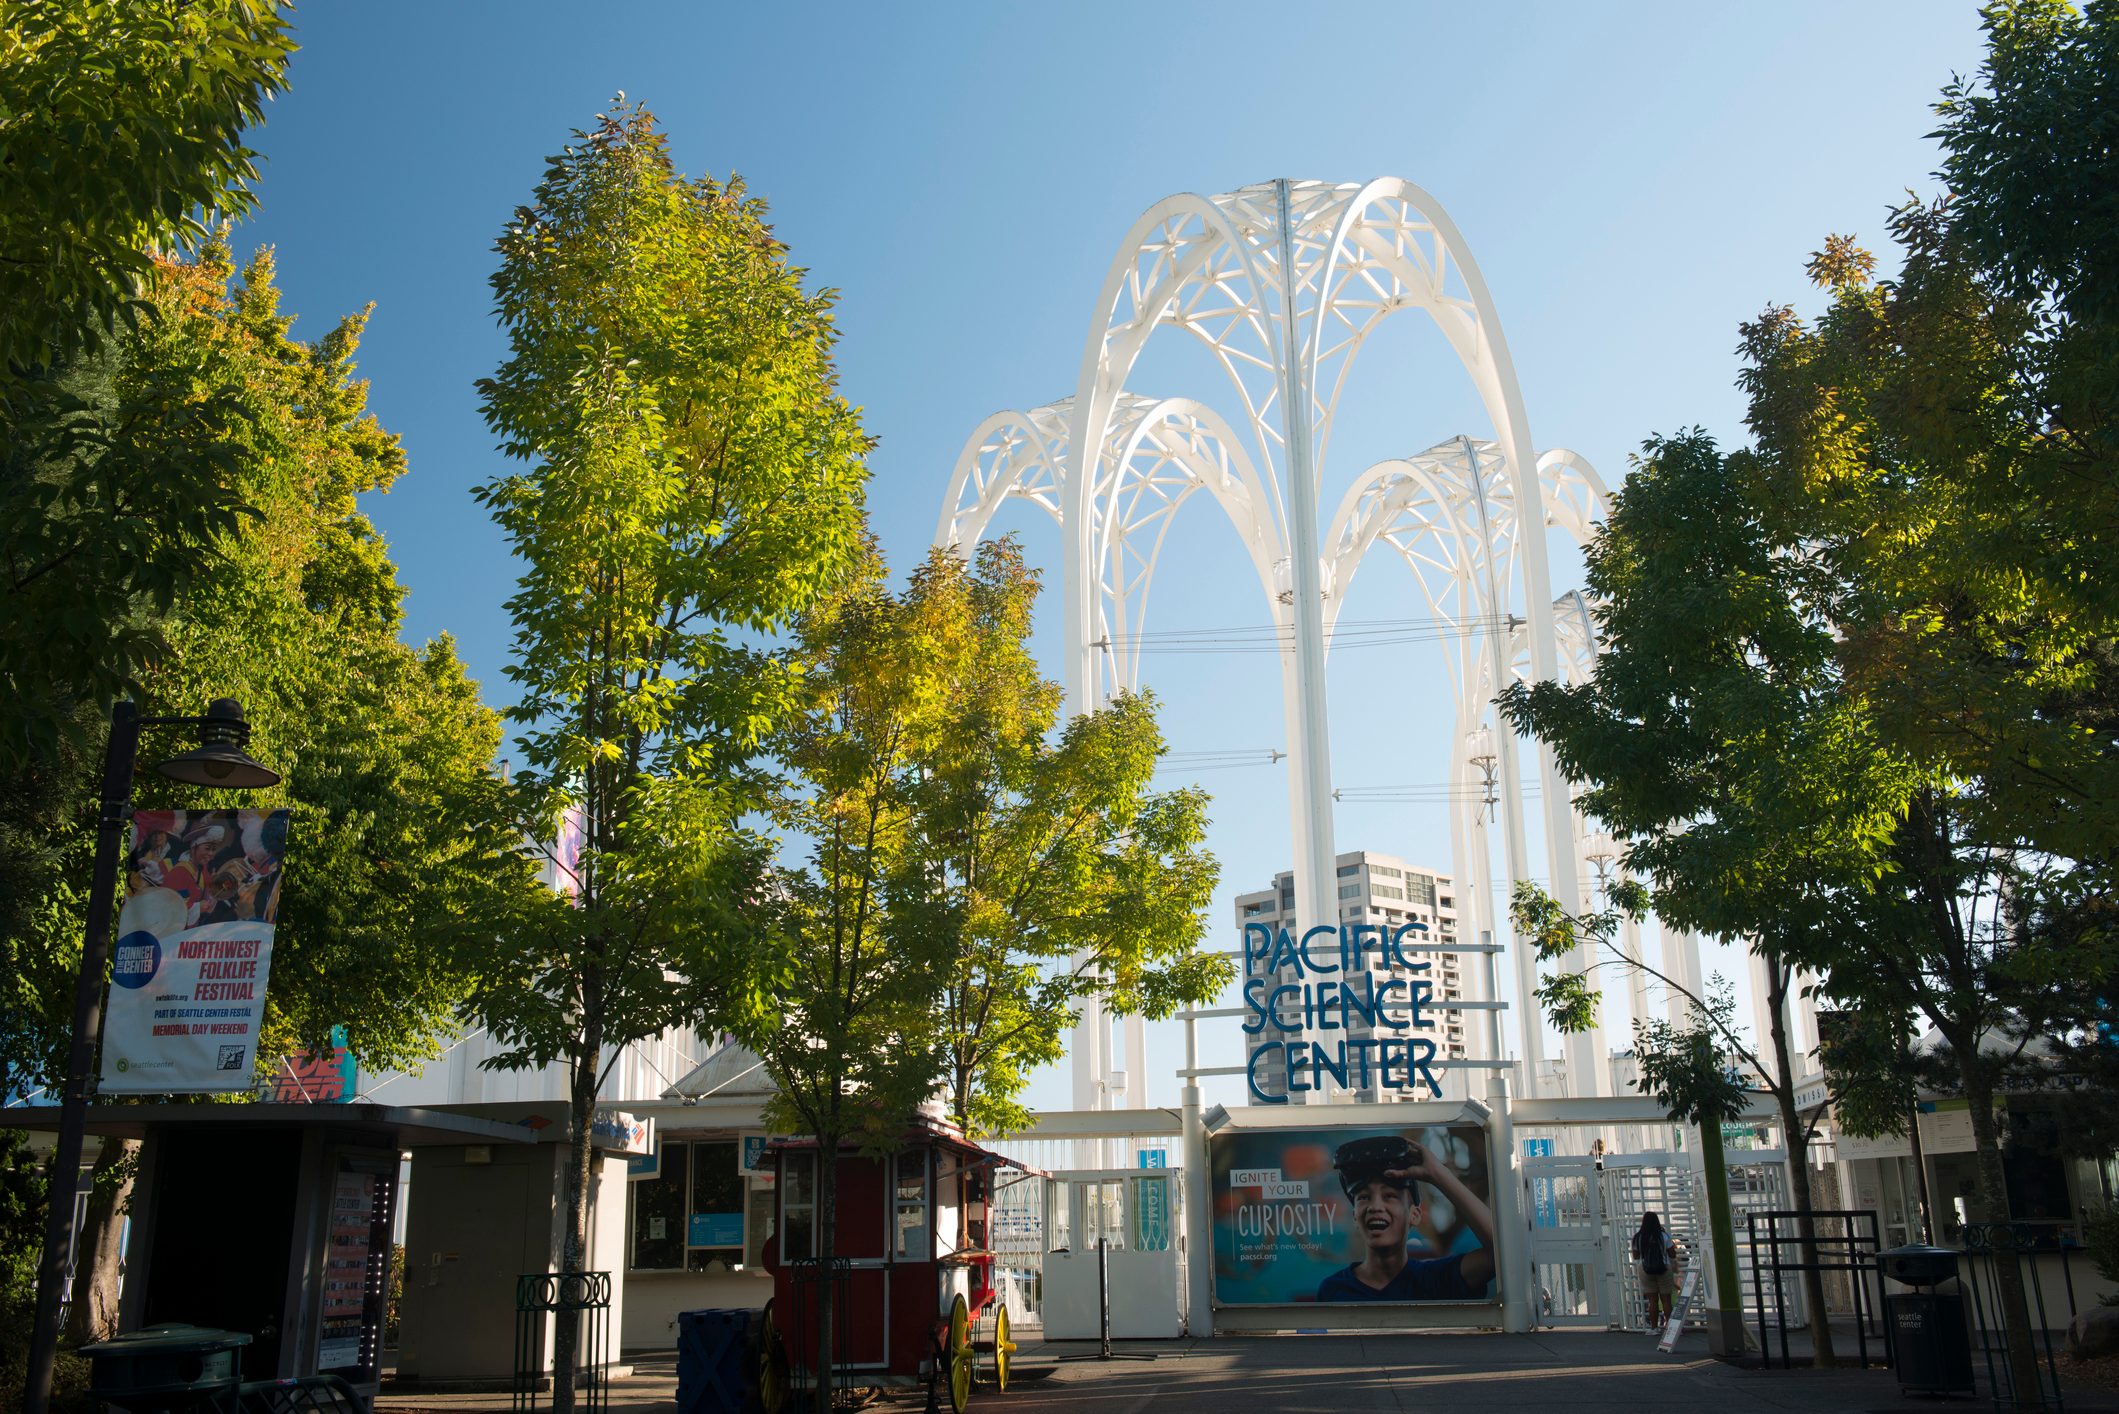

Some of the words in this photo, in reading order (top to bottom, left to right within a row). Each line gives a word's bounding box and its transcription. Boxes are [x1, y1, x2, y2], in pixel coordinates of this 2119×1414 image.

[117, 944, 155, 960] CONNECT
[177, 940, 262, 959] NORTHWEST
[1245, 923, 1432, 979] PACIFIC
[123, 960, 153, 974] CENTER
[199, 961, 257, 980] FOLKLIFE
[194, 983, 254, 1001] FESTIVAL
[1242, 971, 1435, 1034] SCIENCE
[154, 1009, 169, 1019] PART
[169, 1009, 177, 1018] OF
[177, 1008, 204, 1018] SEATTLE
[204, 1008, 229, 1017] CENTER
[152, 1024, 190, 1036] MEMORIAL
[191, 1024, 209, 1035] DAY
[210, 1023, 248, 1035] WEEKEND
[1248, 1038, 1442, 1103] CENTER
[1235, 1172, 1277, 1183] IGNITE
[1268, 1184, 1303, 1195] YOUR
[1238, 1203, 1337, 1237] CURIOSITY
[1239, 1243, 1253, 1251] See
[1254, 1242, 1279, 1251] what's
[1298, 1242, 1322, 1252] today!
[1240, 1253, 1278, 1262] pacsci.org
[1900, 1320, 1921, 1329] center
